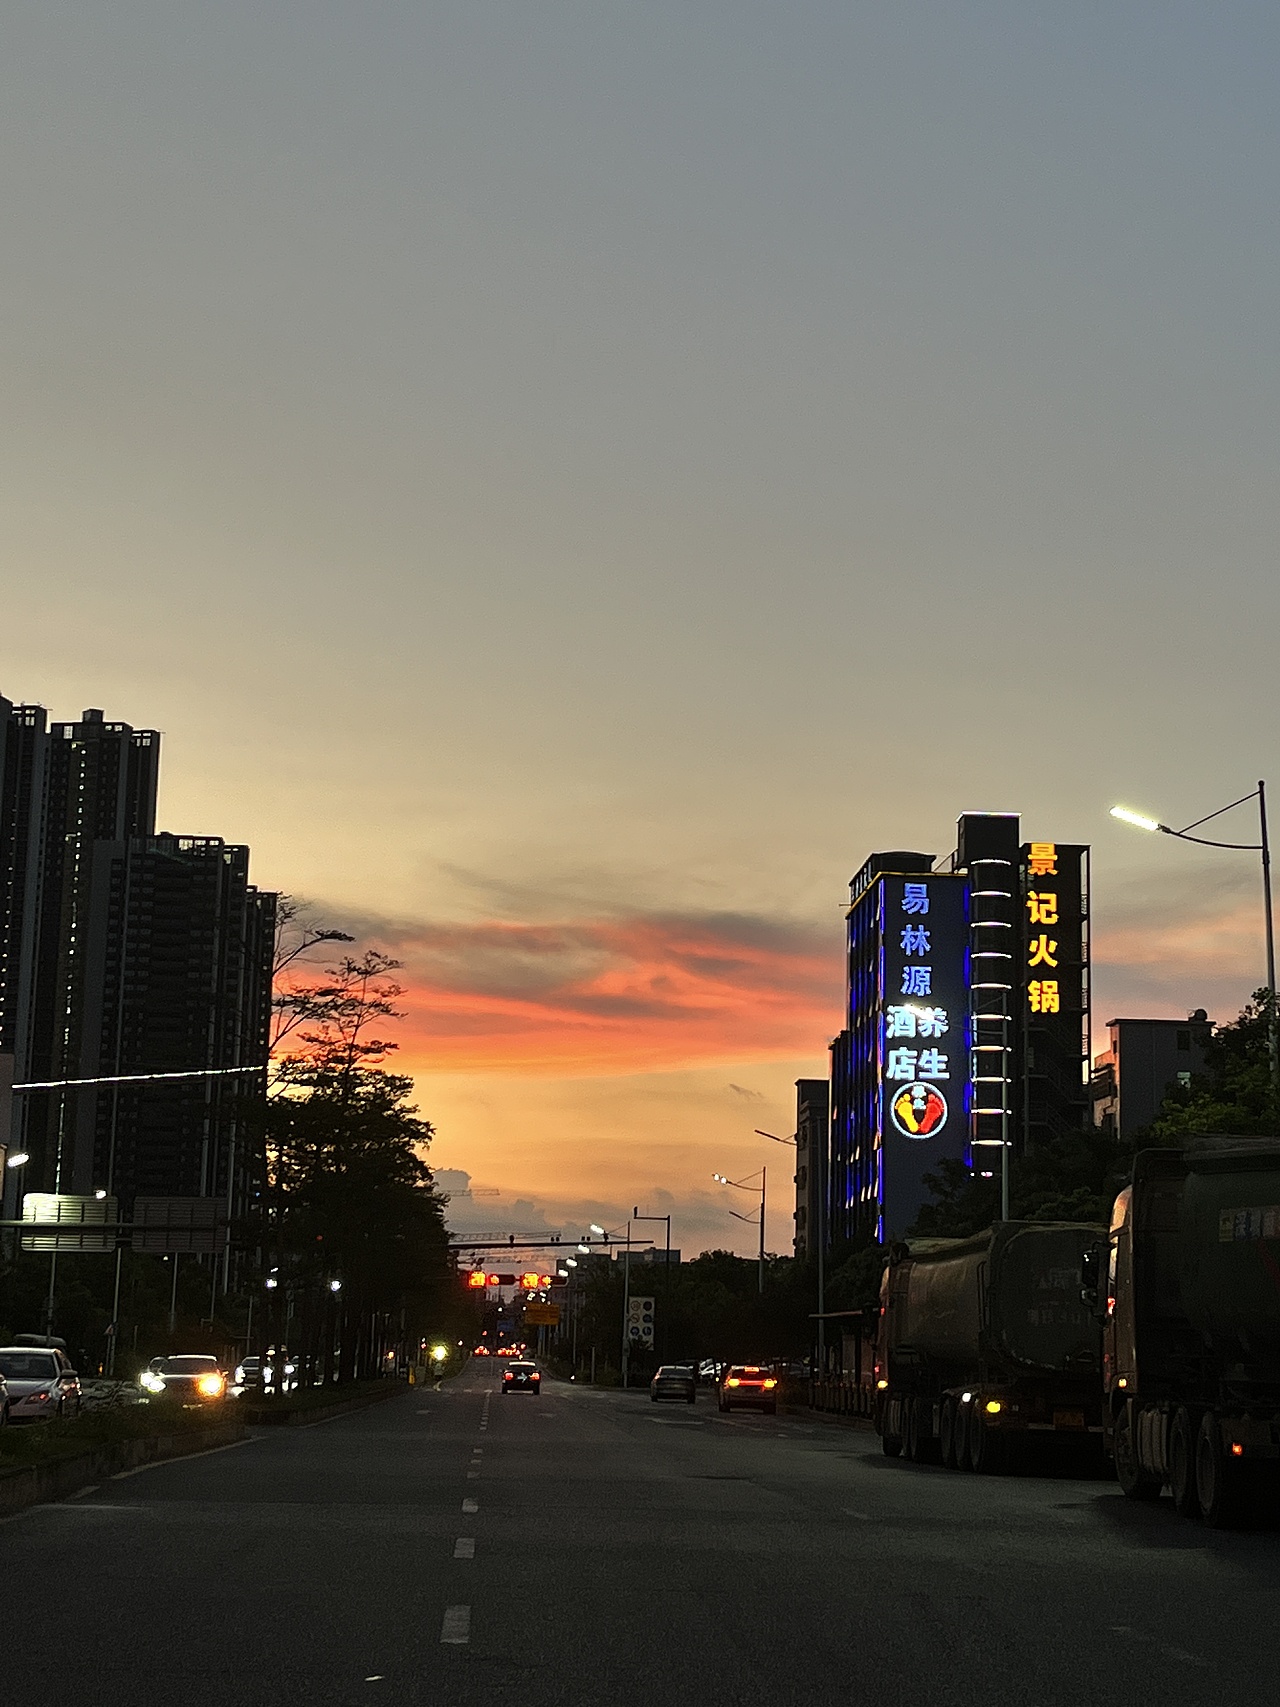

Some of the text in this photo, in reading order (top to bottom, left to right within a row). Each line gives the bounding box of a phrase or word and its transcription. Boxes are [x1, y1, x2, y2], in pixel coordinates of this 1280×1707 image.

[900, 882, 932, 997] 易林源
[1026, 843, 1060, 1014] 景记火锅
